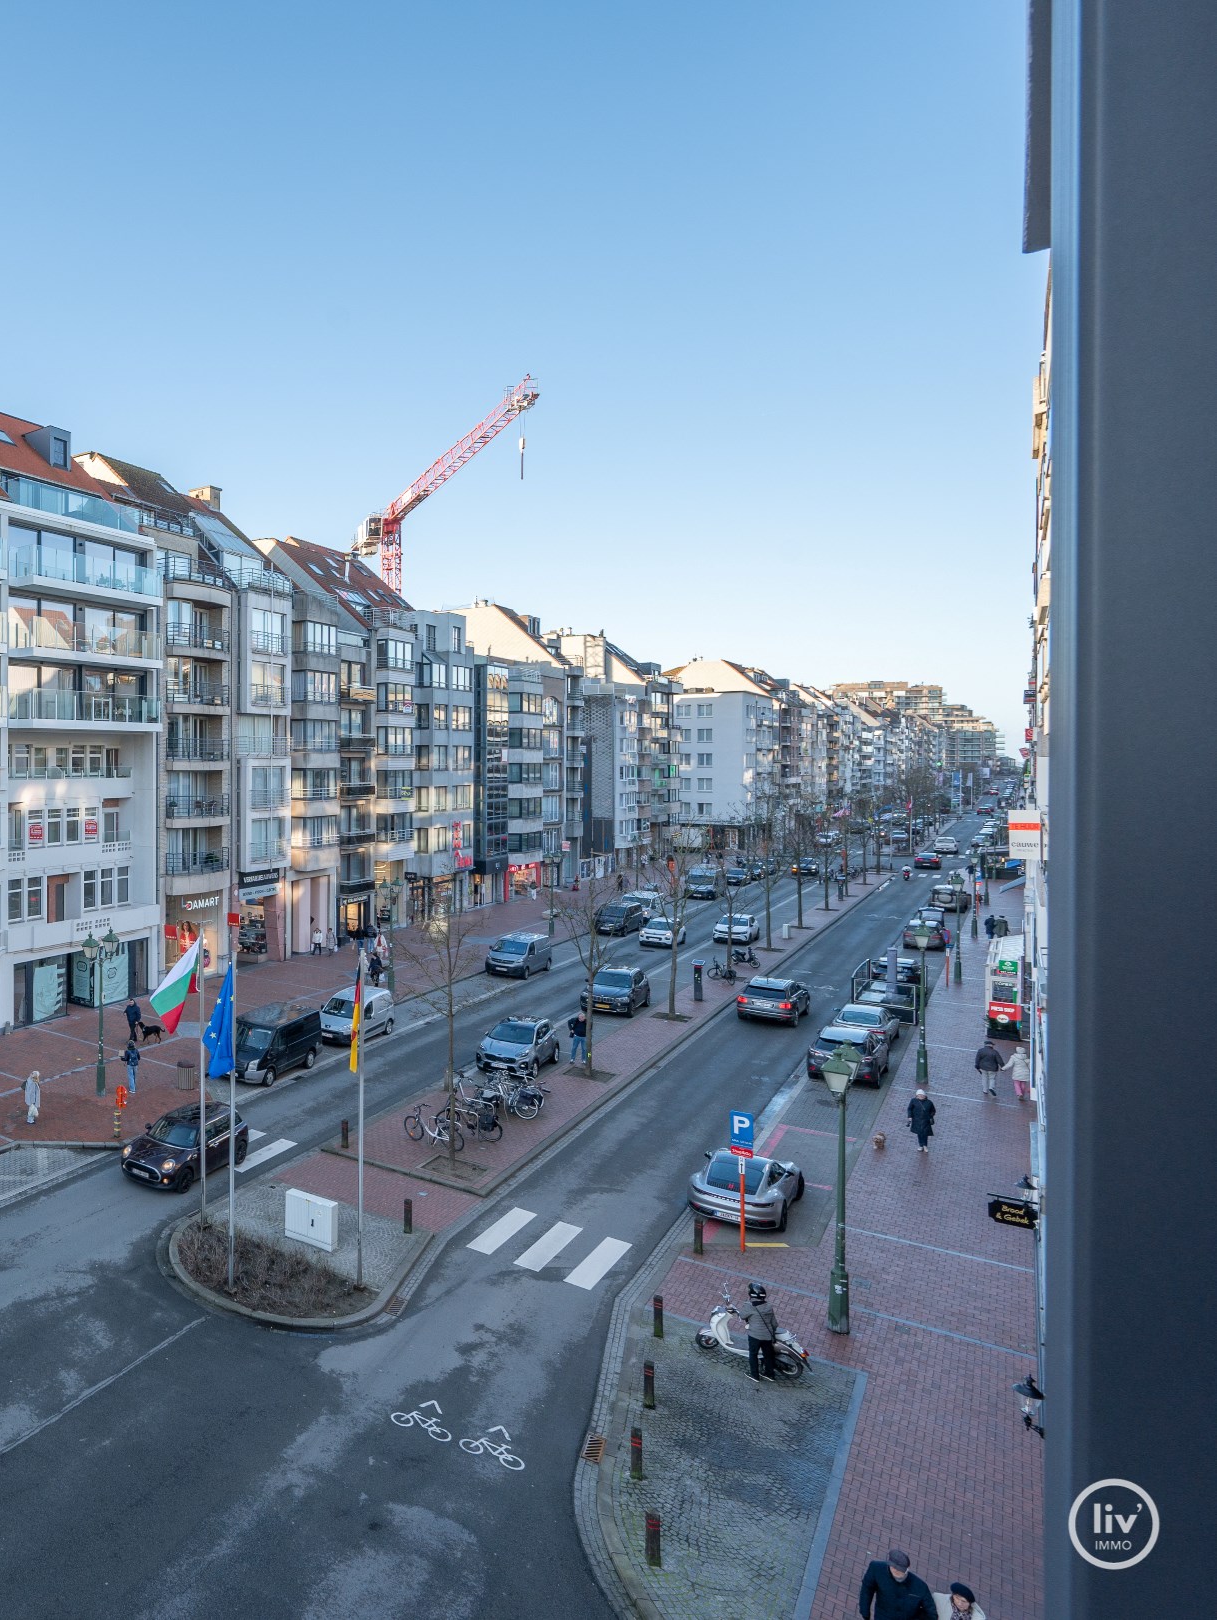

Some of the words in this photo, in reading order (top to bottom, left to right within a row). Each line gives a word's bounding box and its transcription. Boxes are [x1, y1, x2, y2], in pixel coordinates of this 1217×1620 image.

[1011, 841, 1039, 849] cauwe
[185, 896, 220, 911] DAMART
[733, 1115, 750, 1135] P
[1001, 1204, 1025, 1215] Brood
